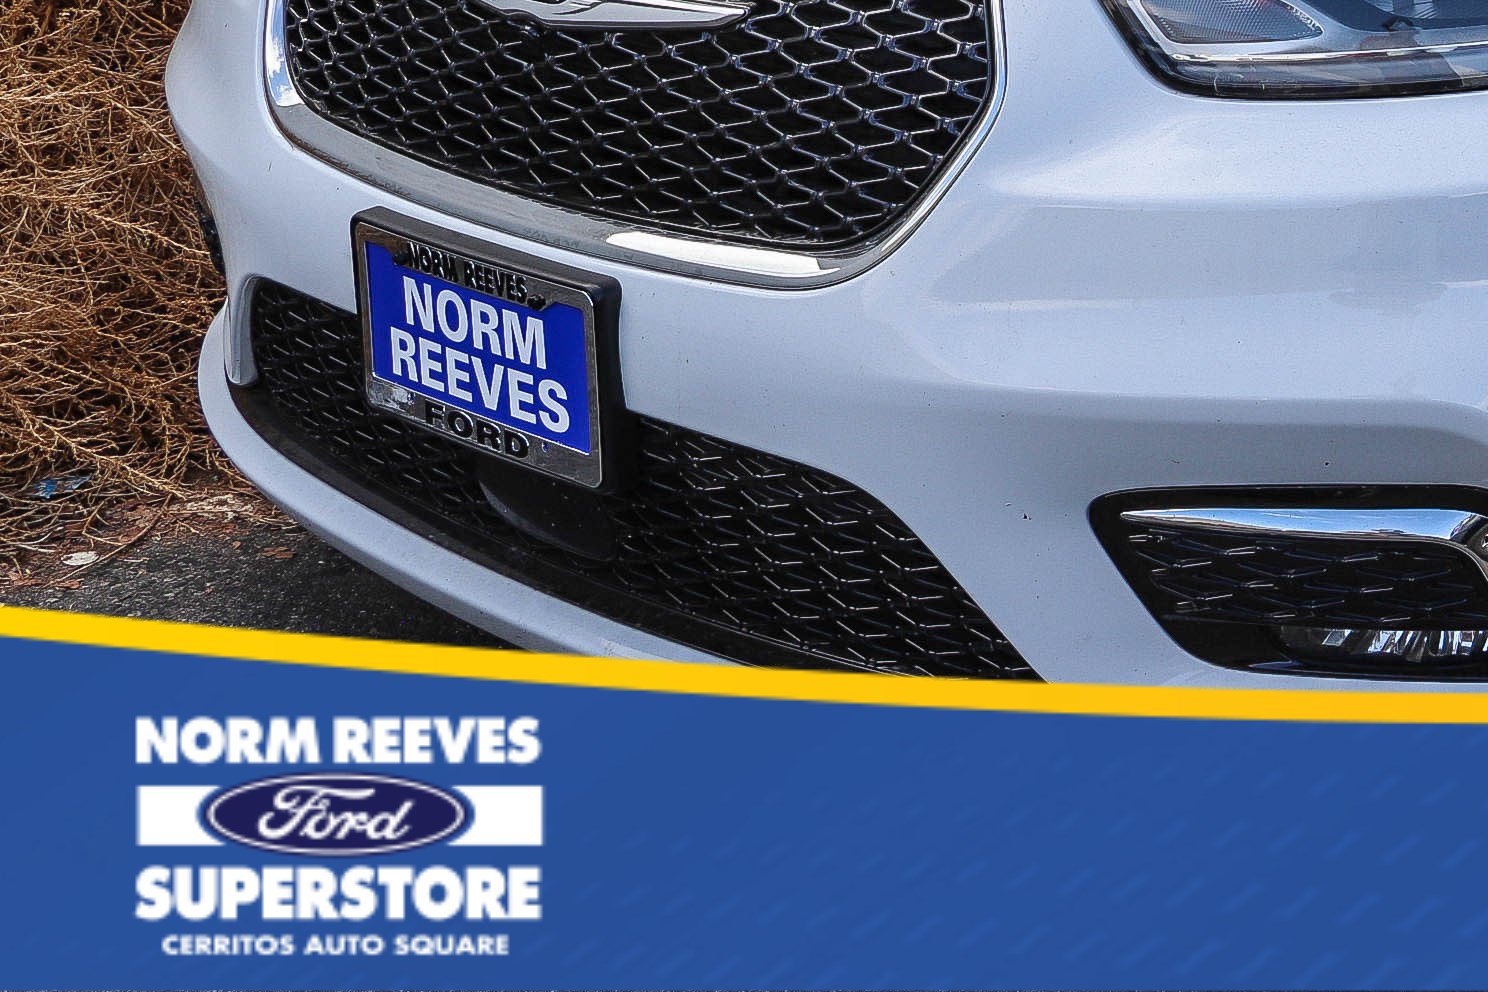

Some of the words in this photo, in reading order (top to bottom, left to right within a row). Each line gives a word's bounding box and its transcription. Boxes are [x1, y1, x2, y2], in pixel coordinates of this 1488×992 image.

[407, 241, 458, 283] NORM
[464, 260, 528, 304] REEVES
[403, 276, 547, 370] NORM
[390, 326, 570, 434] REEVES
[425, 400, 530, 458] FORD
